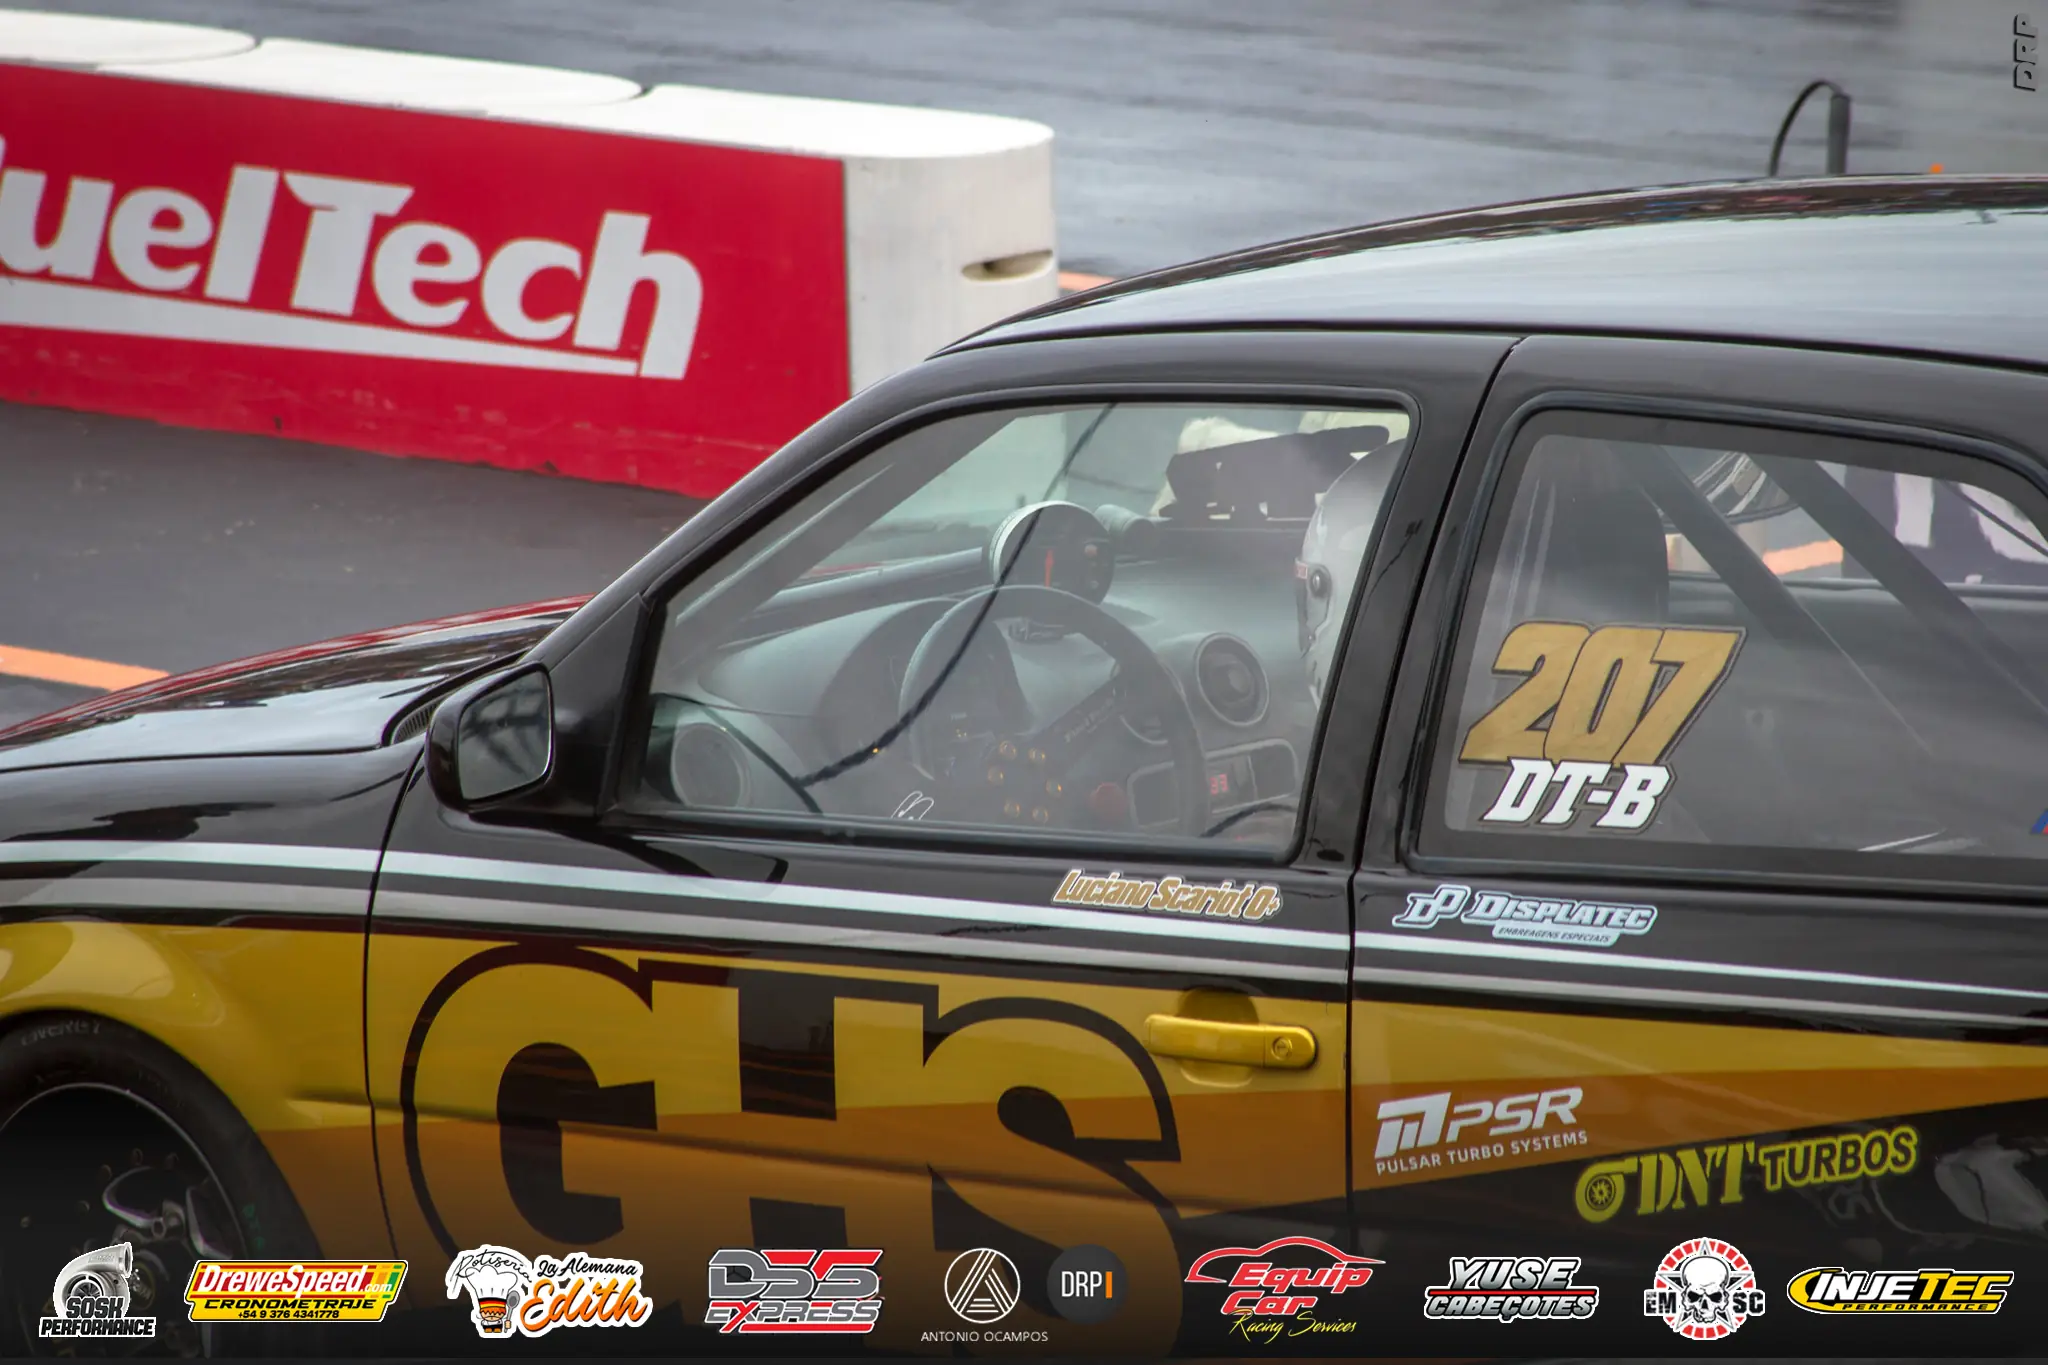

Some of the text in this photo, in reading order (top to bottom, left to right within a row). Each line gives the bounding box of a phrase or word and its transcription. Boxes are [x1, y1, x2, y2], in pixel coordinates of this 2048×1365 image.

[0, 134, 704, 380] uelTech
[1459, 620, 1742, 768] 207
[1480, 757, 1672, 829] DT-B
[1053, 869, 1157, 909] Luciano
[1149, 876, 1255, 918] Scariot
[1467, 893, 1654, 930] DISPLATEC
[1498, 926, 1612, 943] EMBREAGENS ESPECIAIS
[1446, 1087, 1584, 1143] PSR
[1376, 1130, 1588, 1176] PULSAR TURBO SYSTEMS
[1637, 1126, 1918, 1216] DNT TURBOS
